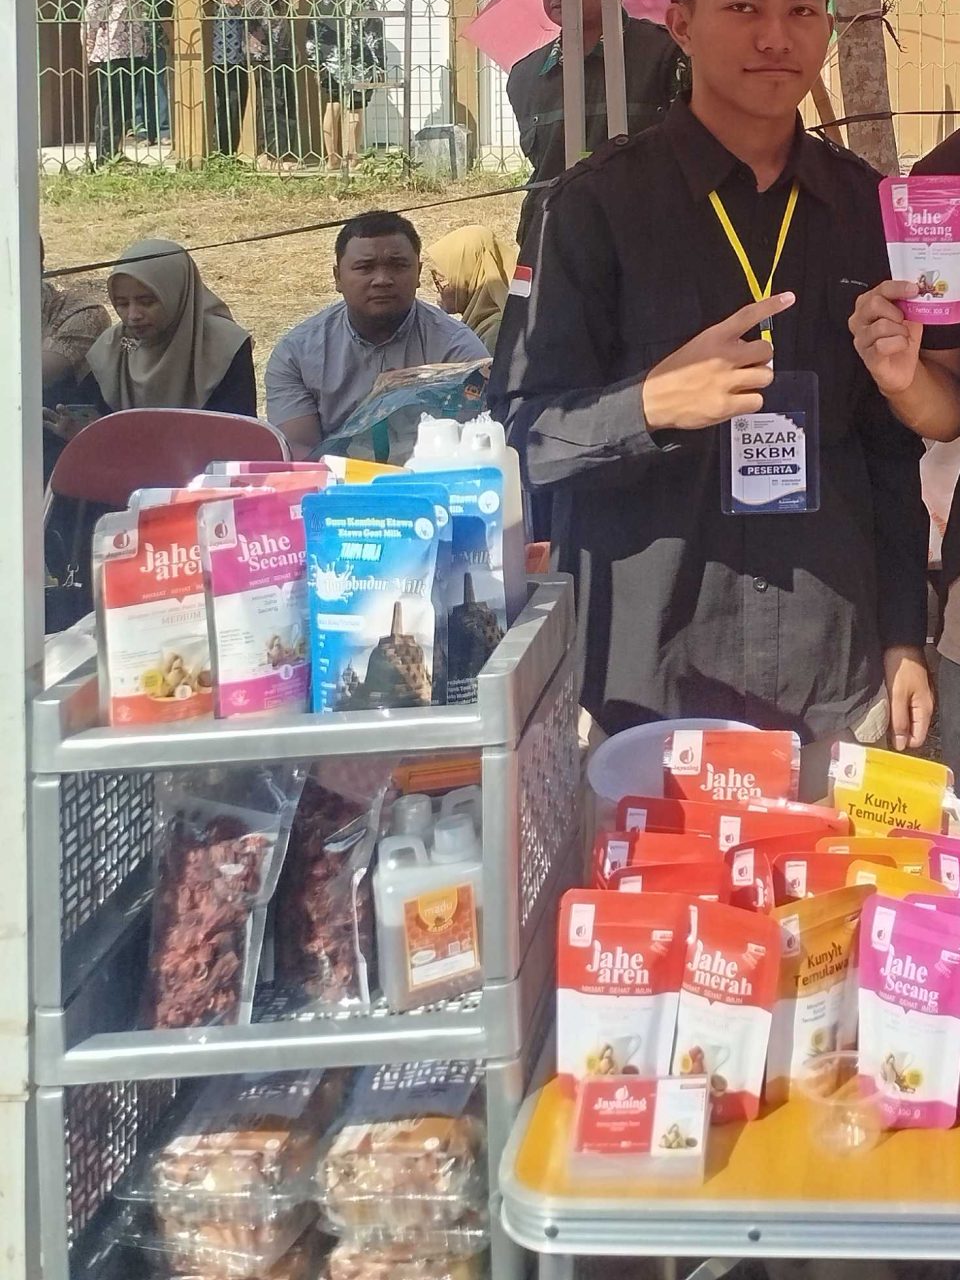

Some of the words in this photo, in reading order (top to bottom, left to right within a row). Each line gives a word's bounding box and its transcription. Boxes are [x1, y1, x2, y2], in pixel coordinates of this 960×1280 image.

[910, 225, 953, 237] Secang
[742, 431, 797, 445] BAZAR
[743, 447, 795, 459] SKBM
[747, 466, 793, 475] PESERTA
[249, 551, 307, 572] Secang
[864, 793, 907, 815] Kunyit
[848, 803, 922, 832] Temulawak
[807, 941, 844, 970] Kunyit
[598, 968, 650, 985] aren
[694, 968, 753, 996] merah
[885, 974, 940, 1008] Secang
